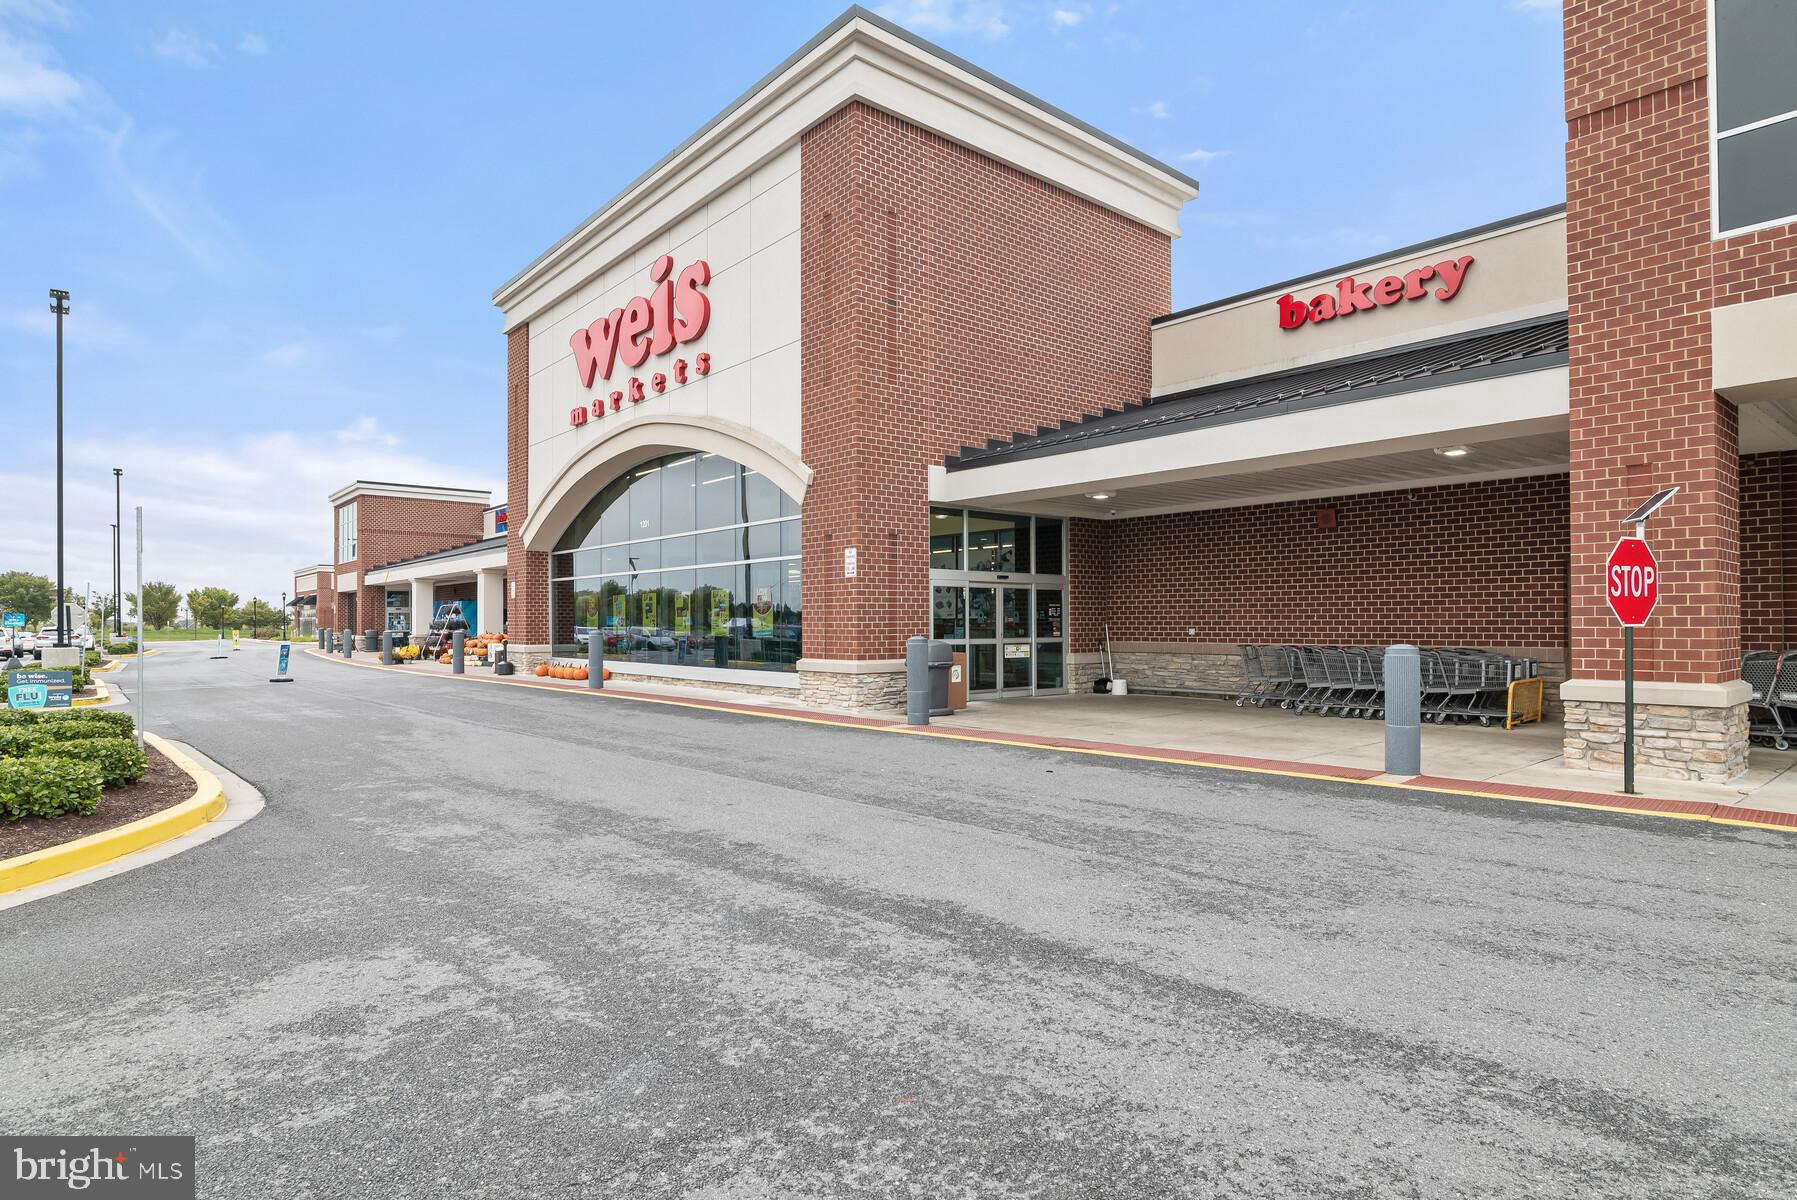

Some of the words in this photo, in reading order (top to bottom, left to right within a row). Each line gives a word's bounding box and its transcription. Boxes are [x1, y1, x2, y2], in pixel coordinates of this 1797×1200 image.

[1276, 255, 1475, 329] bakery
[569, 255, 711, 389] weis
[570, 352, 711, 427] markets
[640, 519, 650, 528] 1201
[1610, 565, 1655, 597] STOP
[15, 692, 39, 701] FLU
